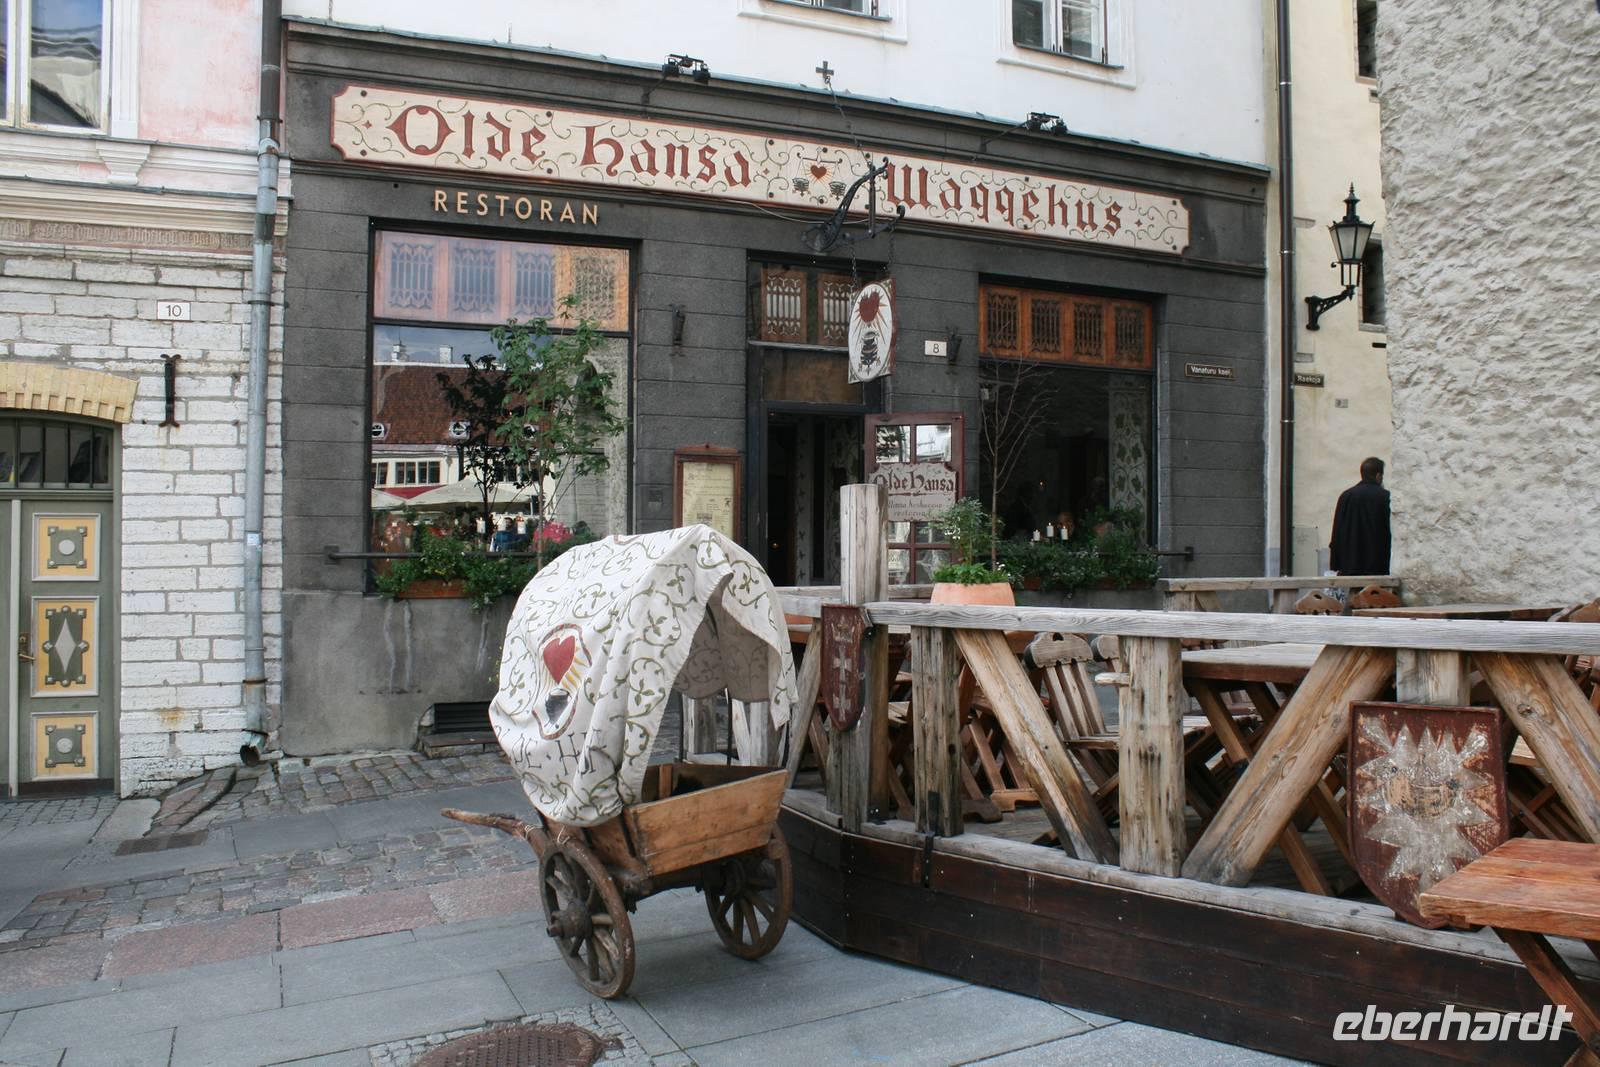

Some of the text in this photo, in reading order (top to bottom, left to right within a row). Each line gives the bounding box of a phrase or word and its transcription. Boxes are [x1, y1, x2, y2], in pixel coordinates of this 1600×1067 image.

[386, 104, 547, 164] Olde
[570, 120, 751, 188] Hansa
[434, 189, 600, 226] RESTORAN
[165, 304, 182, 317] 10
[932, 343, 940, 354] 8
